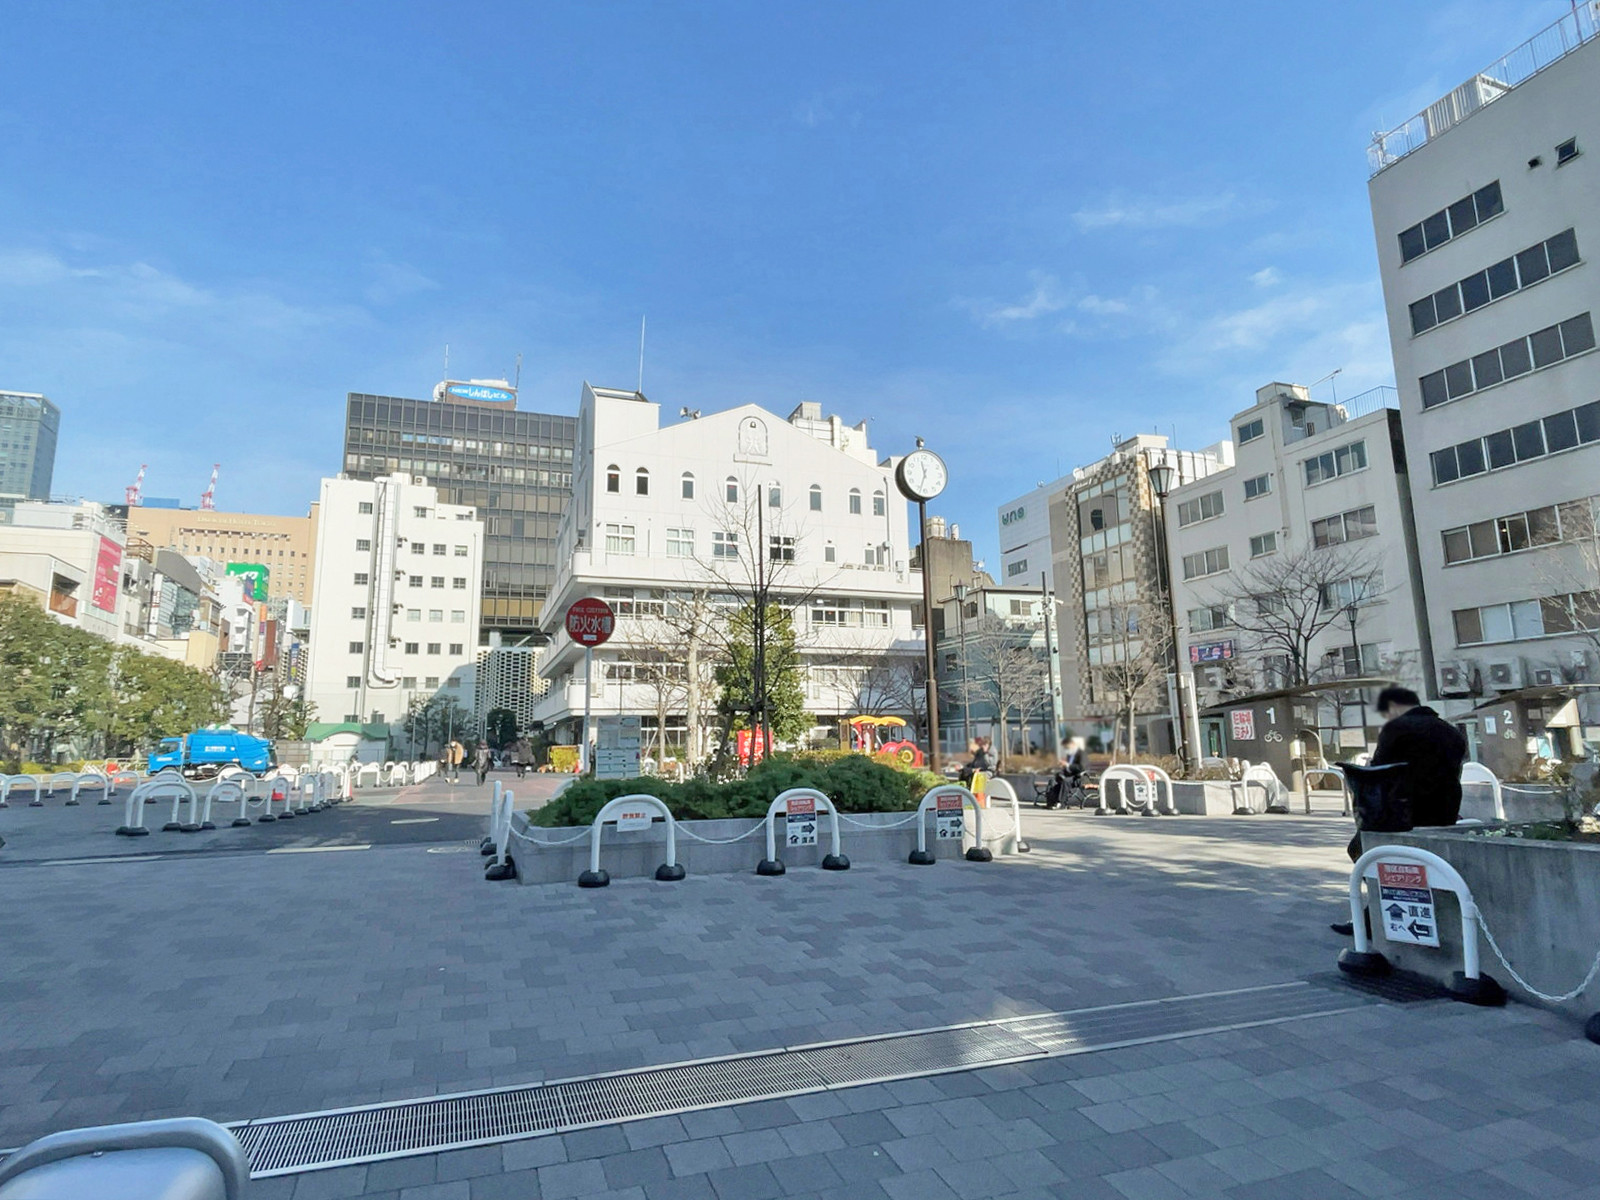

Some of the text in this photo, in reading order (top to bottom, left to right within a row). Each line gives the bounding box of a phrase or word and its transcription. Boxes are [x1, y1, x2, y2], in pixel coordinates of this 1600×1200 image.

[569, 615, 612, 633] 防火水槽
[1266, 707, 1276, 724] 1
[1503, 709, 1513, 724] 2
[1408, 905, 1431, 918] 直進
